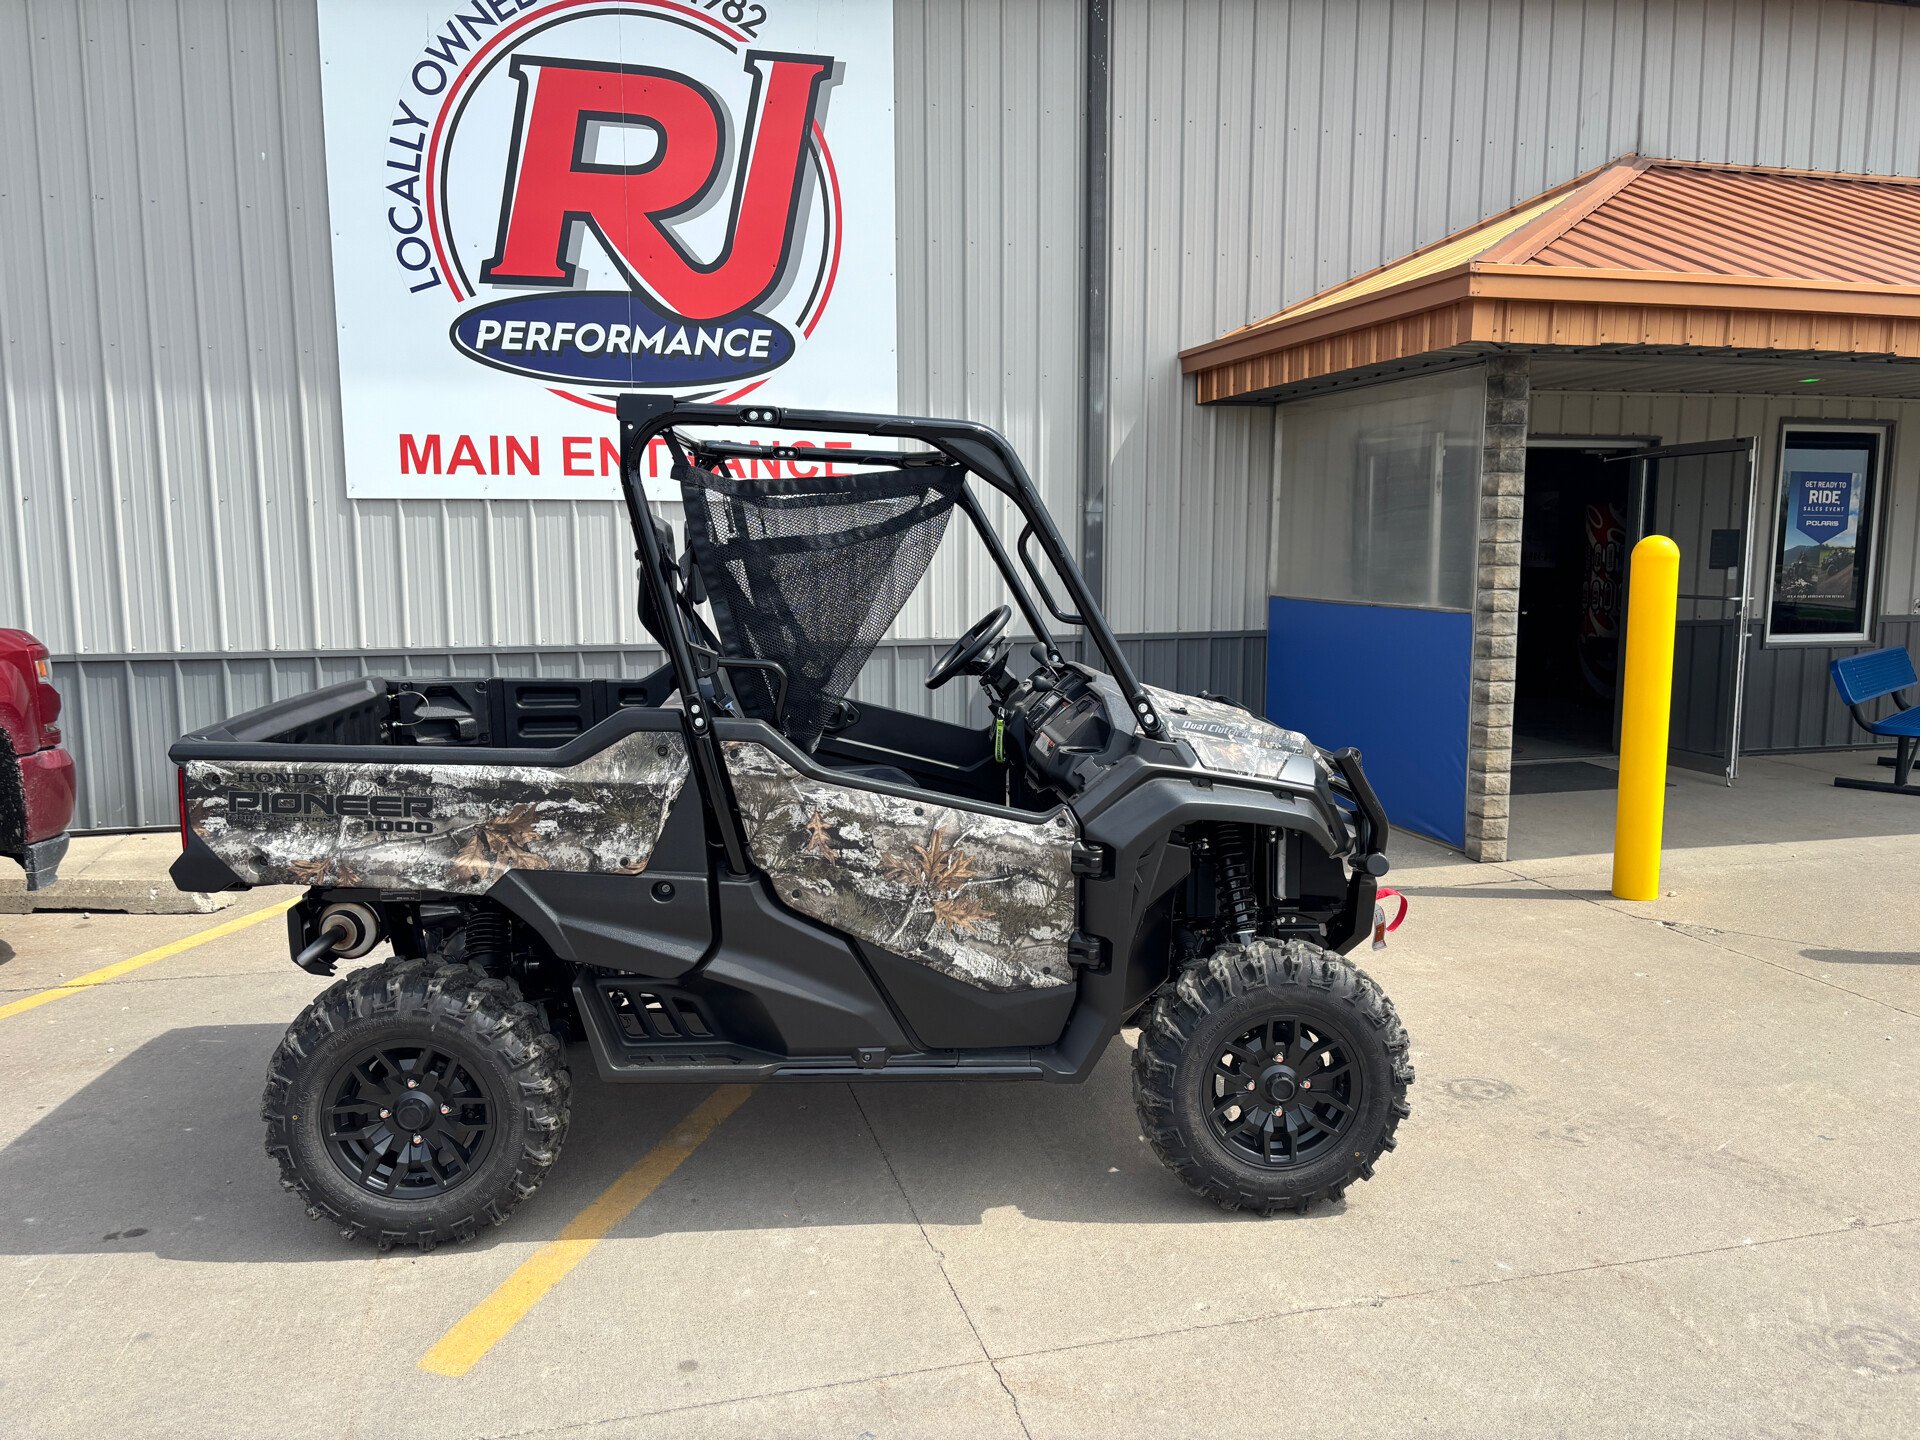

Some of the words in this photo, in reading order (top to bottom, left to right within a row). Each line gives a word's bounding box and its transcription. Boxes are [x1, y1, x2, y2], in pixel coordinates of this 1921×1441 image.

[690, 0, 767, 40] 82
[411, 0, 538, 96] OWNE
[385, 100, 442, 294] LOCALLY
[479, 49, 836, 322] RJ
[475, 319, 772, 359] PERFORMANCE
[399, 433, 541, 477] MAIN
[562, 436, 853, 479] ENTANCE
[1809, 490, 1841, 505] RIDE
[1818, 481, 1839, 489] READY
[1182, 720, 1206, 731] Dual
[1207, 724, 1239, 736] Clutch
[237, 772, 328, 785] HONDA
[228, 791, 434, 818] PIONEER
[364, 819, 434, 833] 1000
